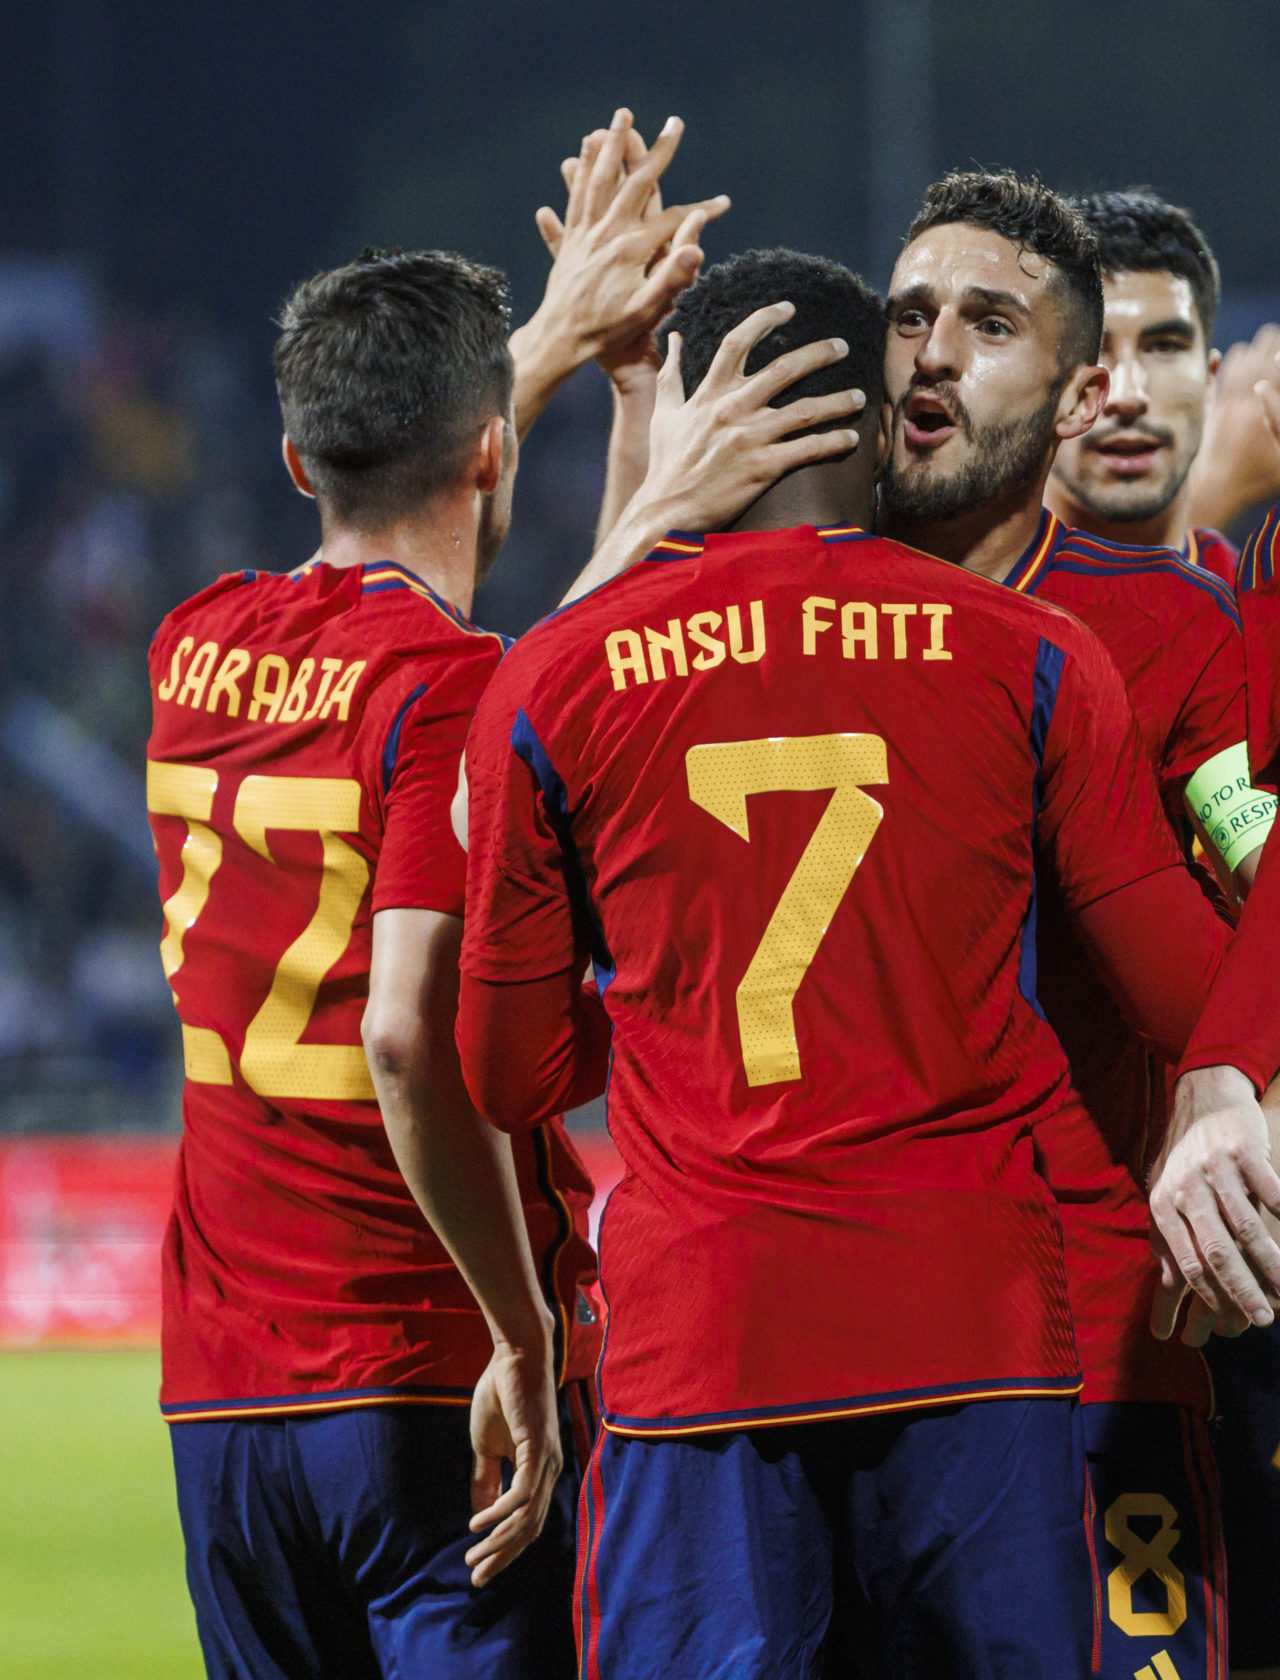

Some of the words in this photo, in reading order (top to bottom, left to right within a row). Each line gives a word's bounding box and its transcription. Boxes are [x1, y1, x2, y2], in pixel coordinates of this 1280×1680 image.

[158, 636, 367, 723] SARABIA
[605, 600, 766, 691] ANSU
[802, 596, 953, 661] FATI
[1211, 785, 1233, 807] TO
[685, 732, 890, 1088] 7
[1104, 1493, 1187, 1637] 8
